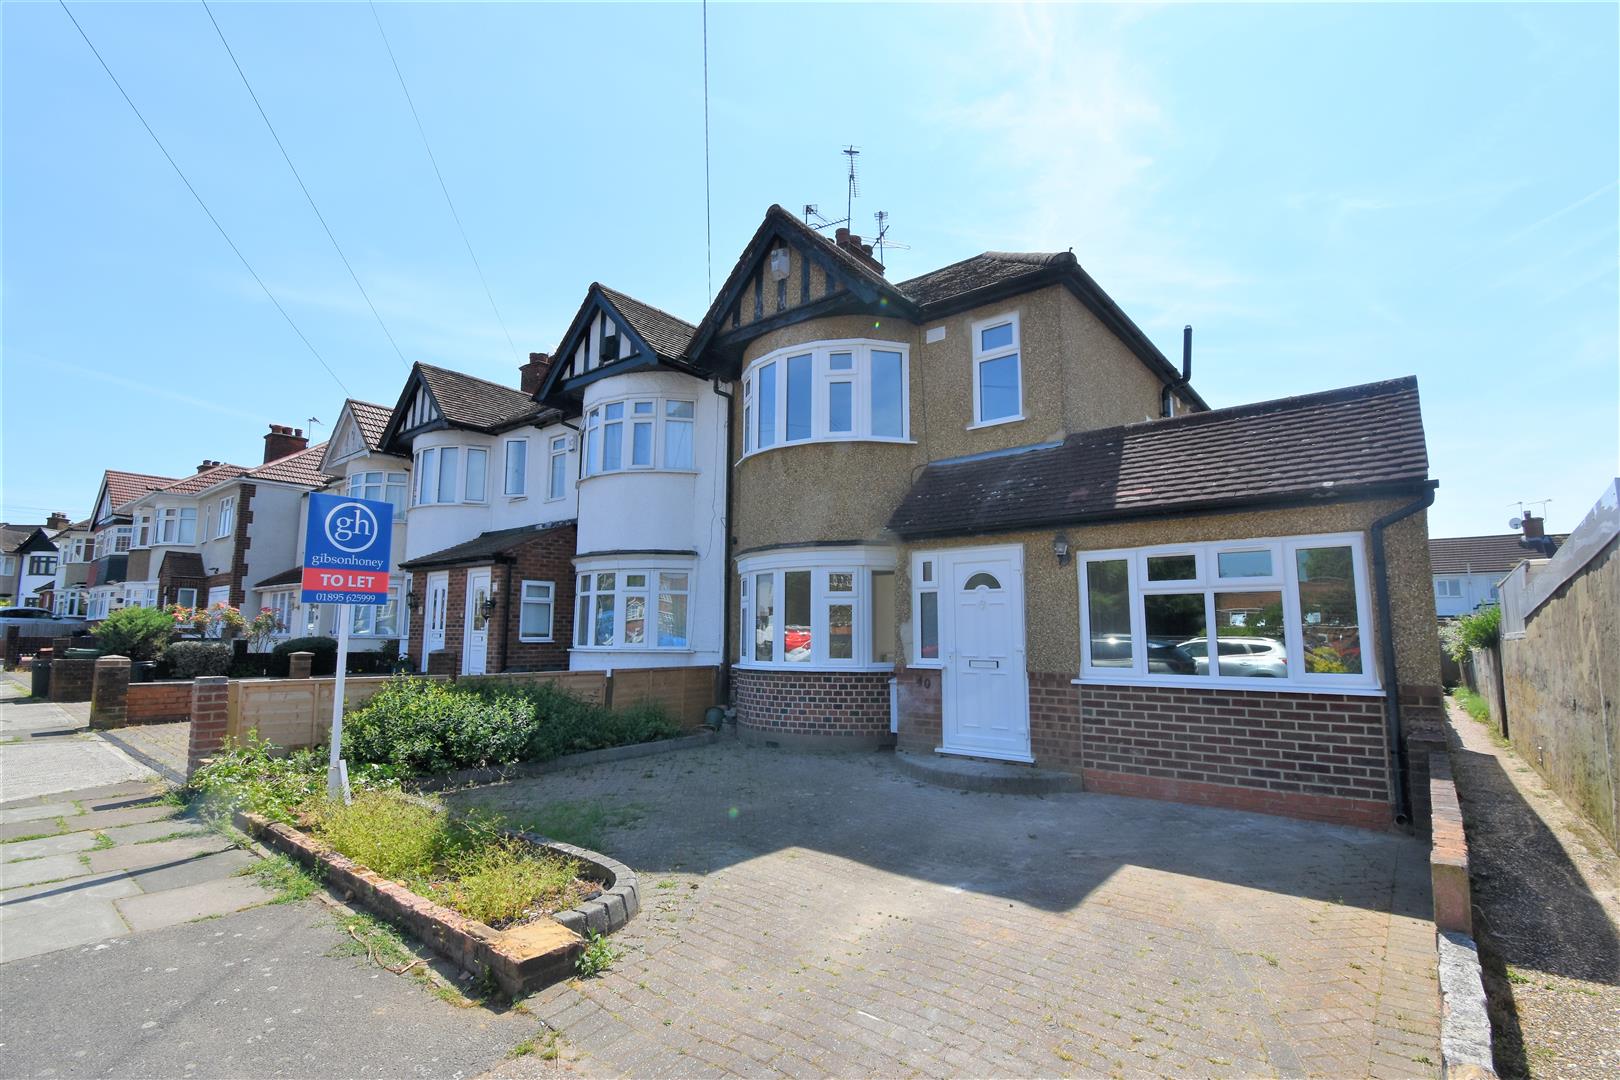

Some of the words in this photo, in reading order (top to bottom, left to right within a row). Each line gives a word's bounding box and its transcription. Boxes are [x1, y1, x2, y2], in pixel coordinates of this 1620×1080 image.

[335, 509, 371, 541] gh
[311, 553, 384, 570] gibsonhoney
[320, 574, 344, 587] TO
[348, 575, 375, 588] LET
[316, 593, 344, 601] 01895
[346, 594, 376, 603] 625999
